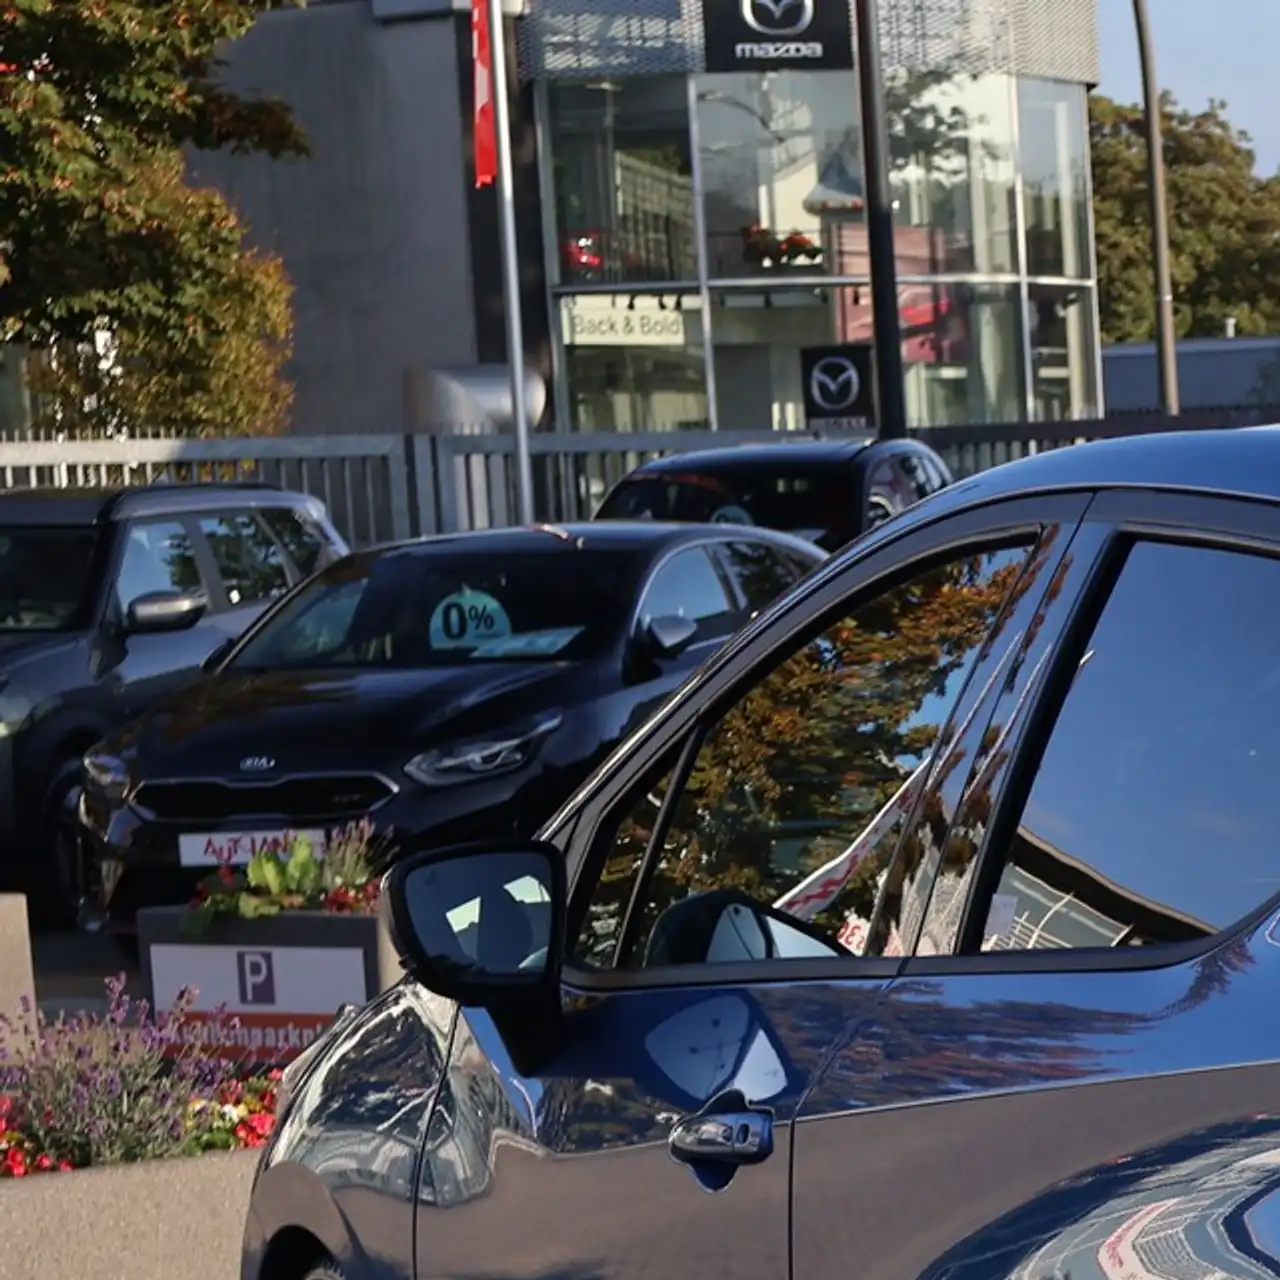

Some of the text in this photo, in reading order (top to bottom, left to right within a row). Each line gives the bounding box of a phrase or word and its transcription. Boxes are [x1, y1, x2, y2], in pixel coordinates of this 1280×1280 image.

[574, 313, 680, 336] Back & Bold
[442, 602, 495, 641] 0%
